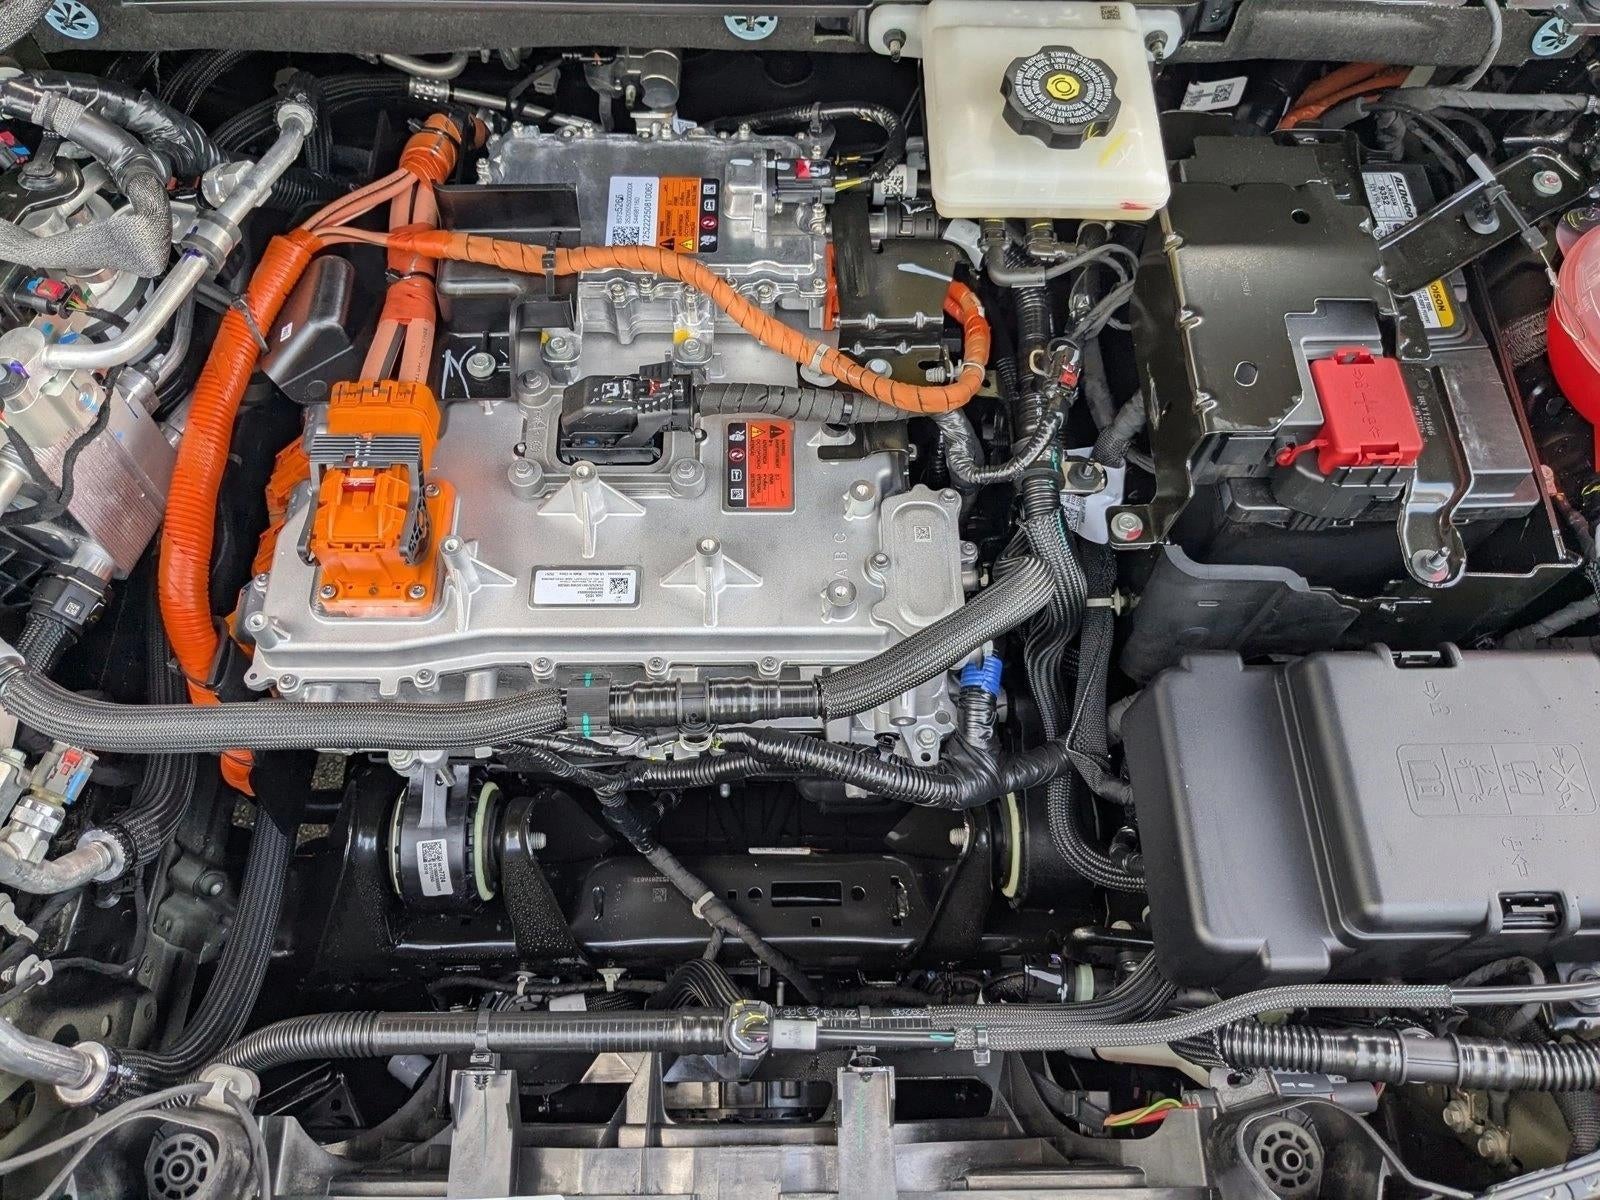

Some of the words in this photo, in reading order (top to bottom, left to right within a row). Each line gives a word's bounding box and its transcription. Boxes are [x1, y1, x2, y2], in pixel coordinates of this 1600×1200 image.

[1082, 58, 1102, 73] SEALED
[1035, 110, 1064, 124] NETTOYER
[1379, 185, 1390, 206] 9352
[1393, 175, 1414, 218] ACDelco
[642, 182, 653, 242] 125222250810062
[1430, 282, 1447, 312] OISON
[833, 532, 848, 543] C
[833, 551, 848, 561] B
[834, 568, 848, 580] A
